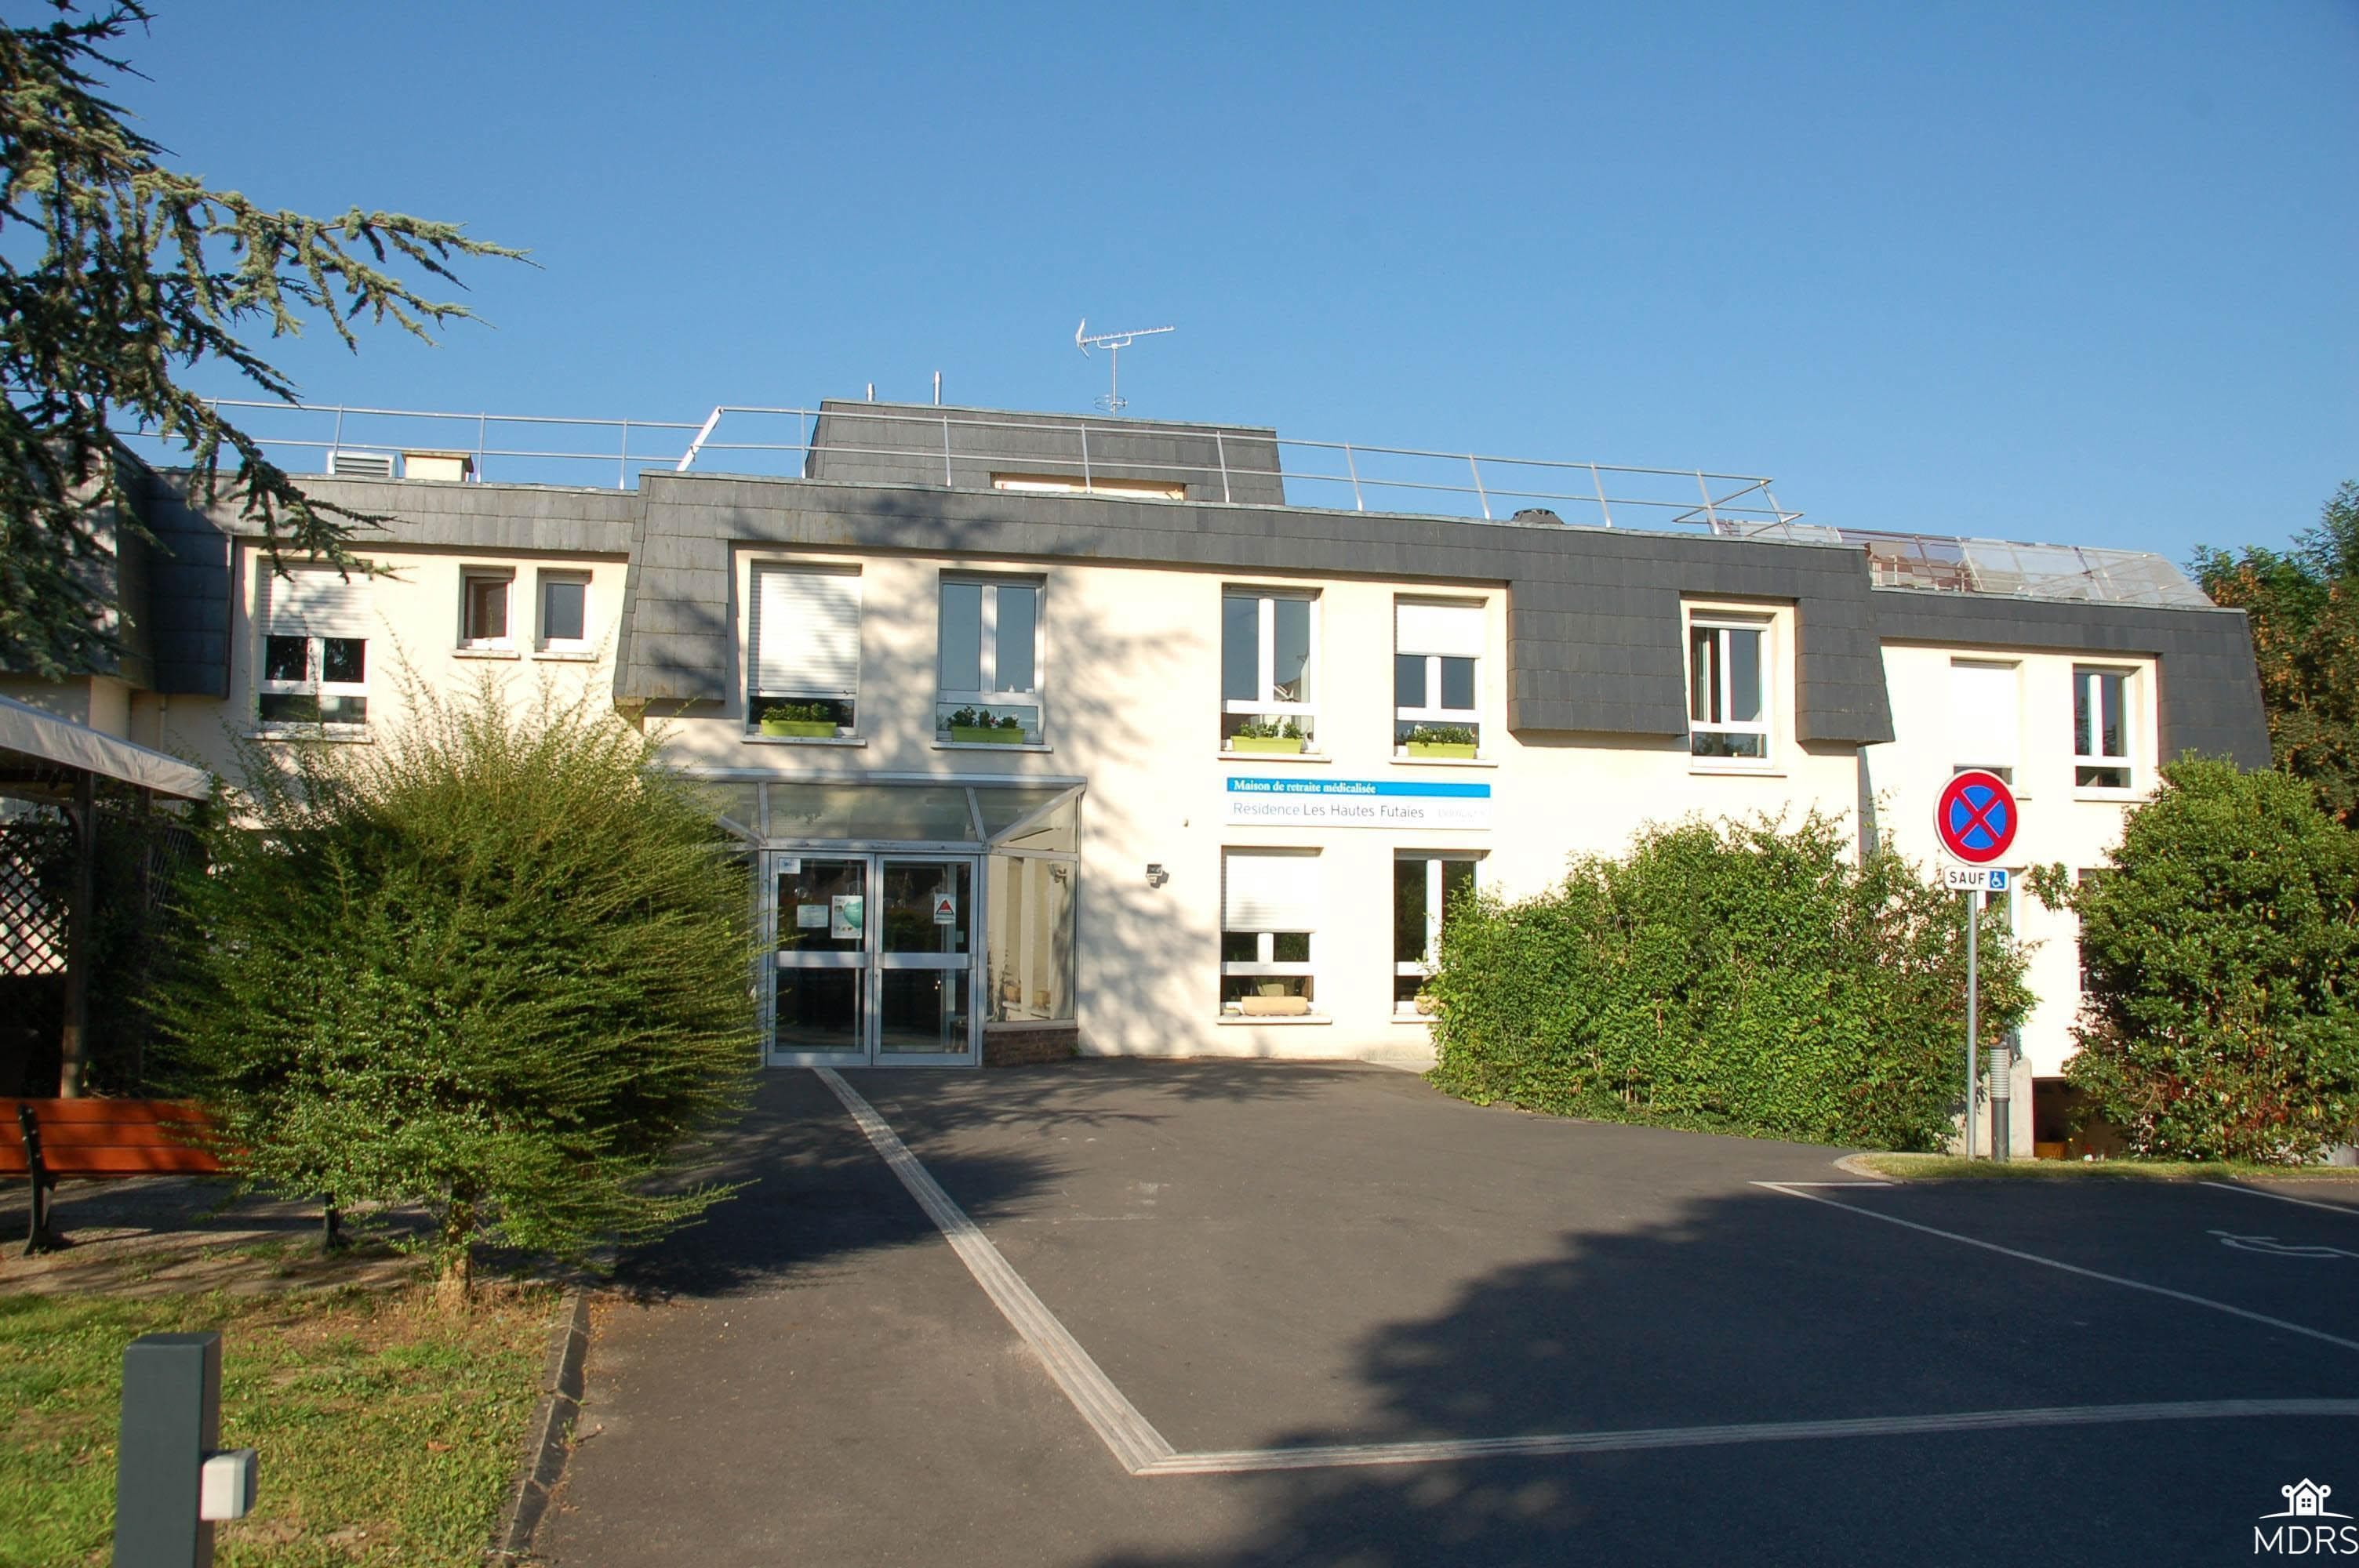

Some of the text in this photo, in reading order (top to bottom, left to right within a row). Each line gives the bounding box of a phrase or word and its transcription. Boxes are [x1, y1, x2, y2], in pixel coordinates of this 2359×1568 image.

[1234, 780, 1376, 793] Maison de retraite médicalisée
[1234, 802, 1299, 815] Résidence
[1303, 804, 1325, 816] Les
[1331, 804, 1374, 817] Hautes
[1381, 805, 1424, 818] Futaies
[1950, 871, 1985, 884] SAUF
